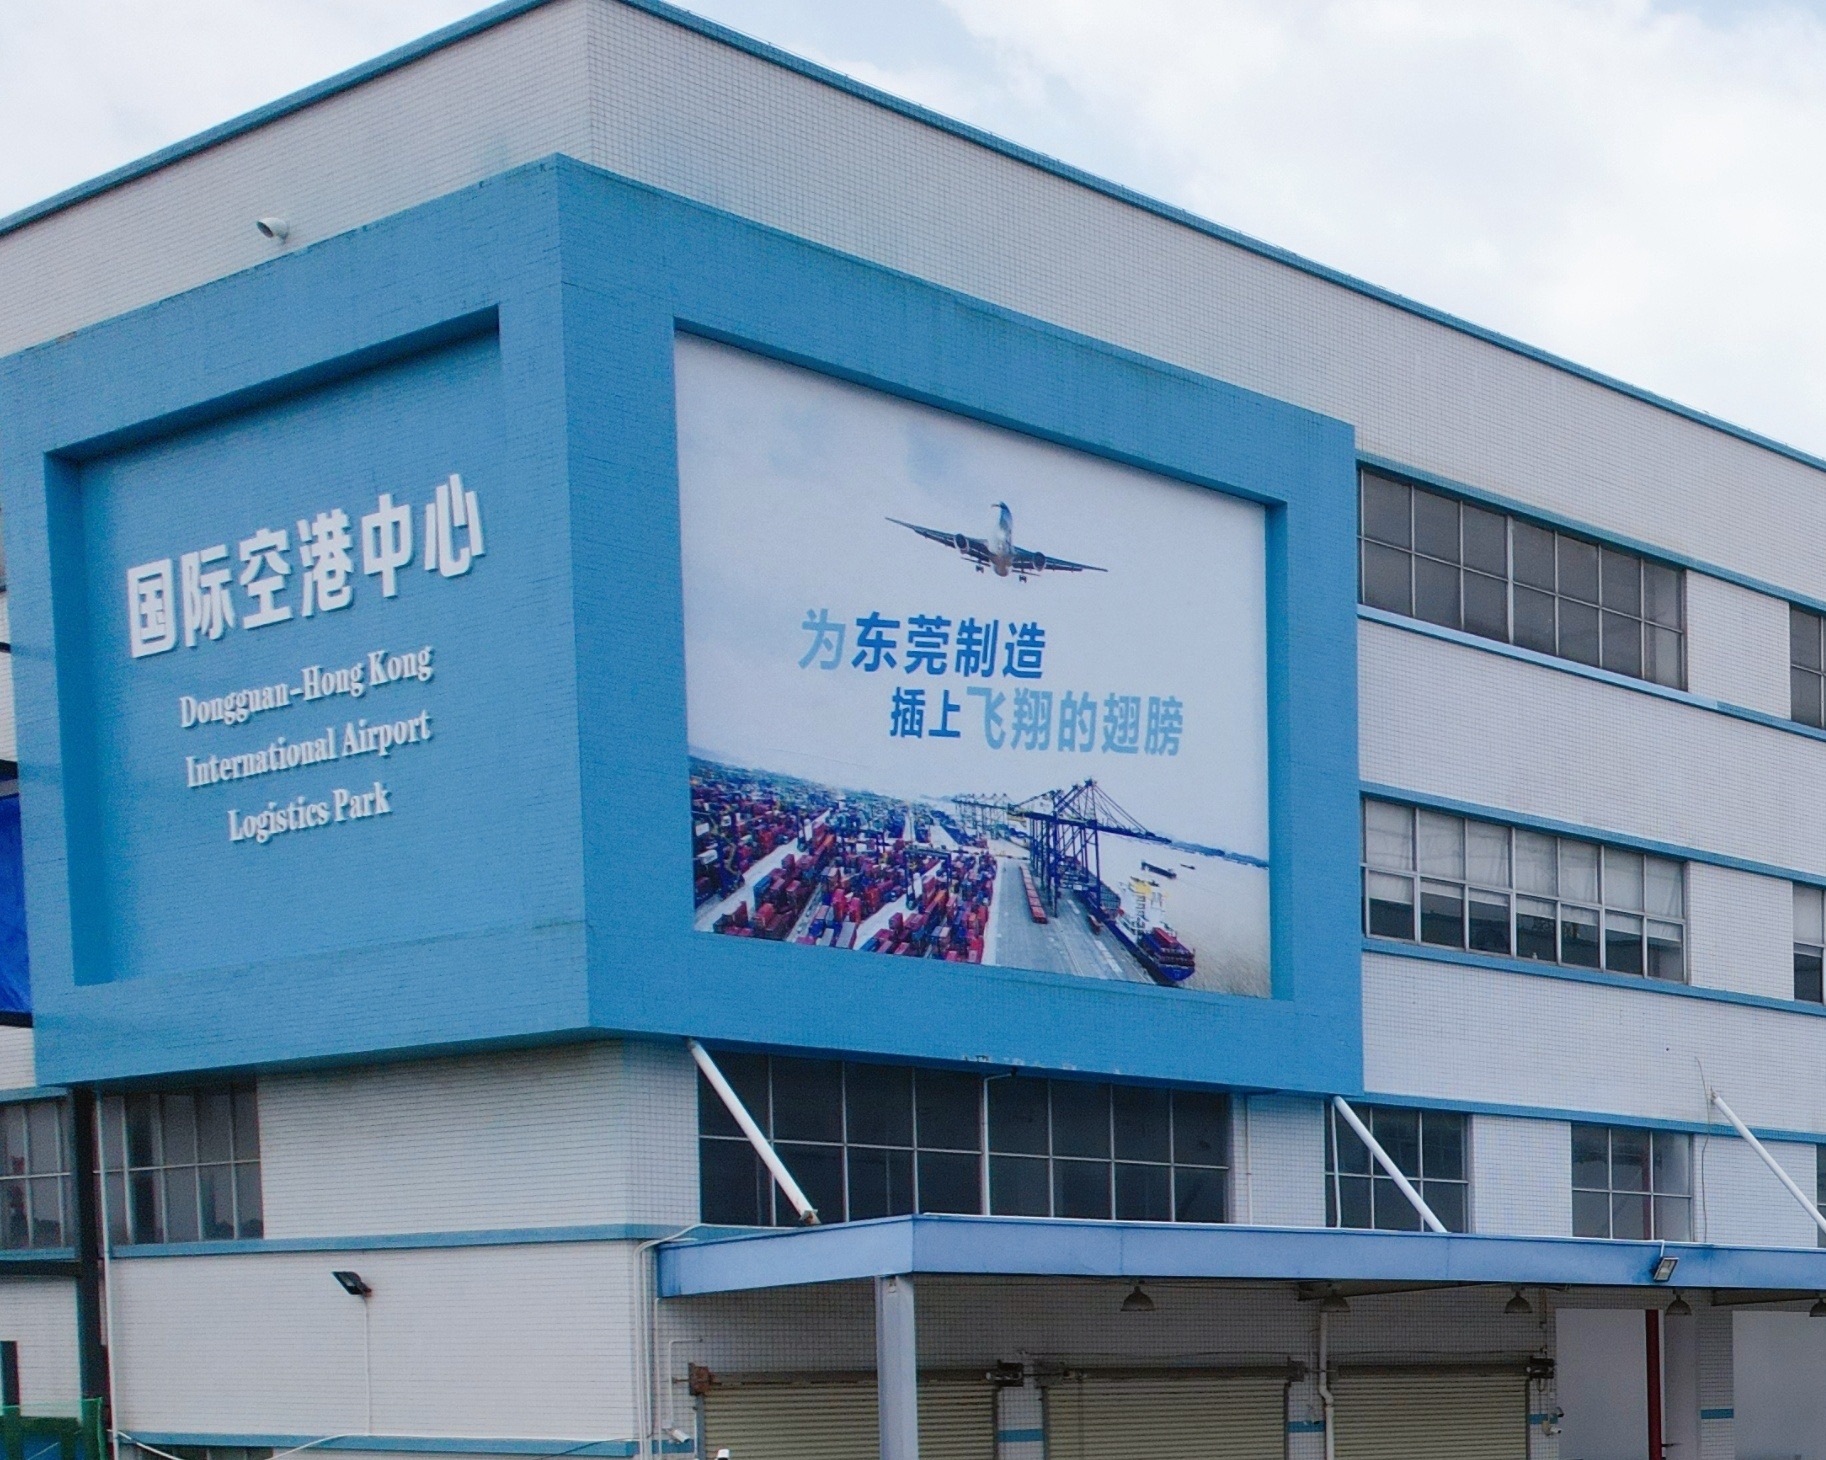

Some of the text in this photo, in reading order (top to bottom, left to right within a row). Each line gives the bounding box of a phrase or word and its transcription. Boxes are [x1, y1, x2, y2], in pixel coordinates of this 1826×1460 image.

[127, 474, 486, 658] 国际空港中心
[367, 646, 435, 686] Kong
[798, 608, 1046, 680] 为东莞制造
[185, 709, 434, 788] International Airport
[889, 685, 1184, 757] 插上飞翔的翅膀
[227, 781, 394, 844] Logistics Park
